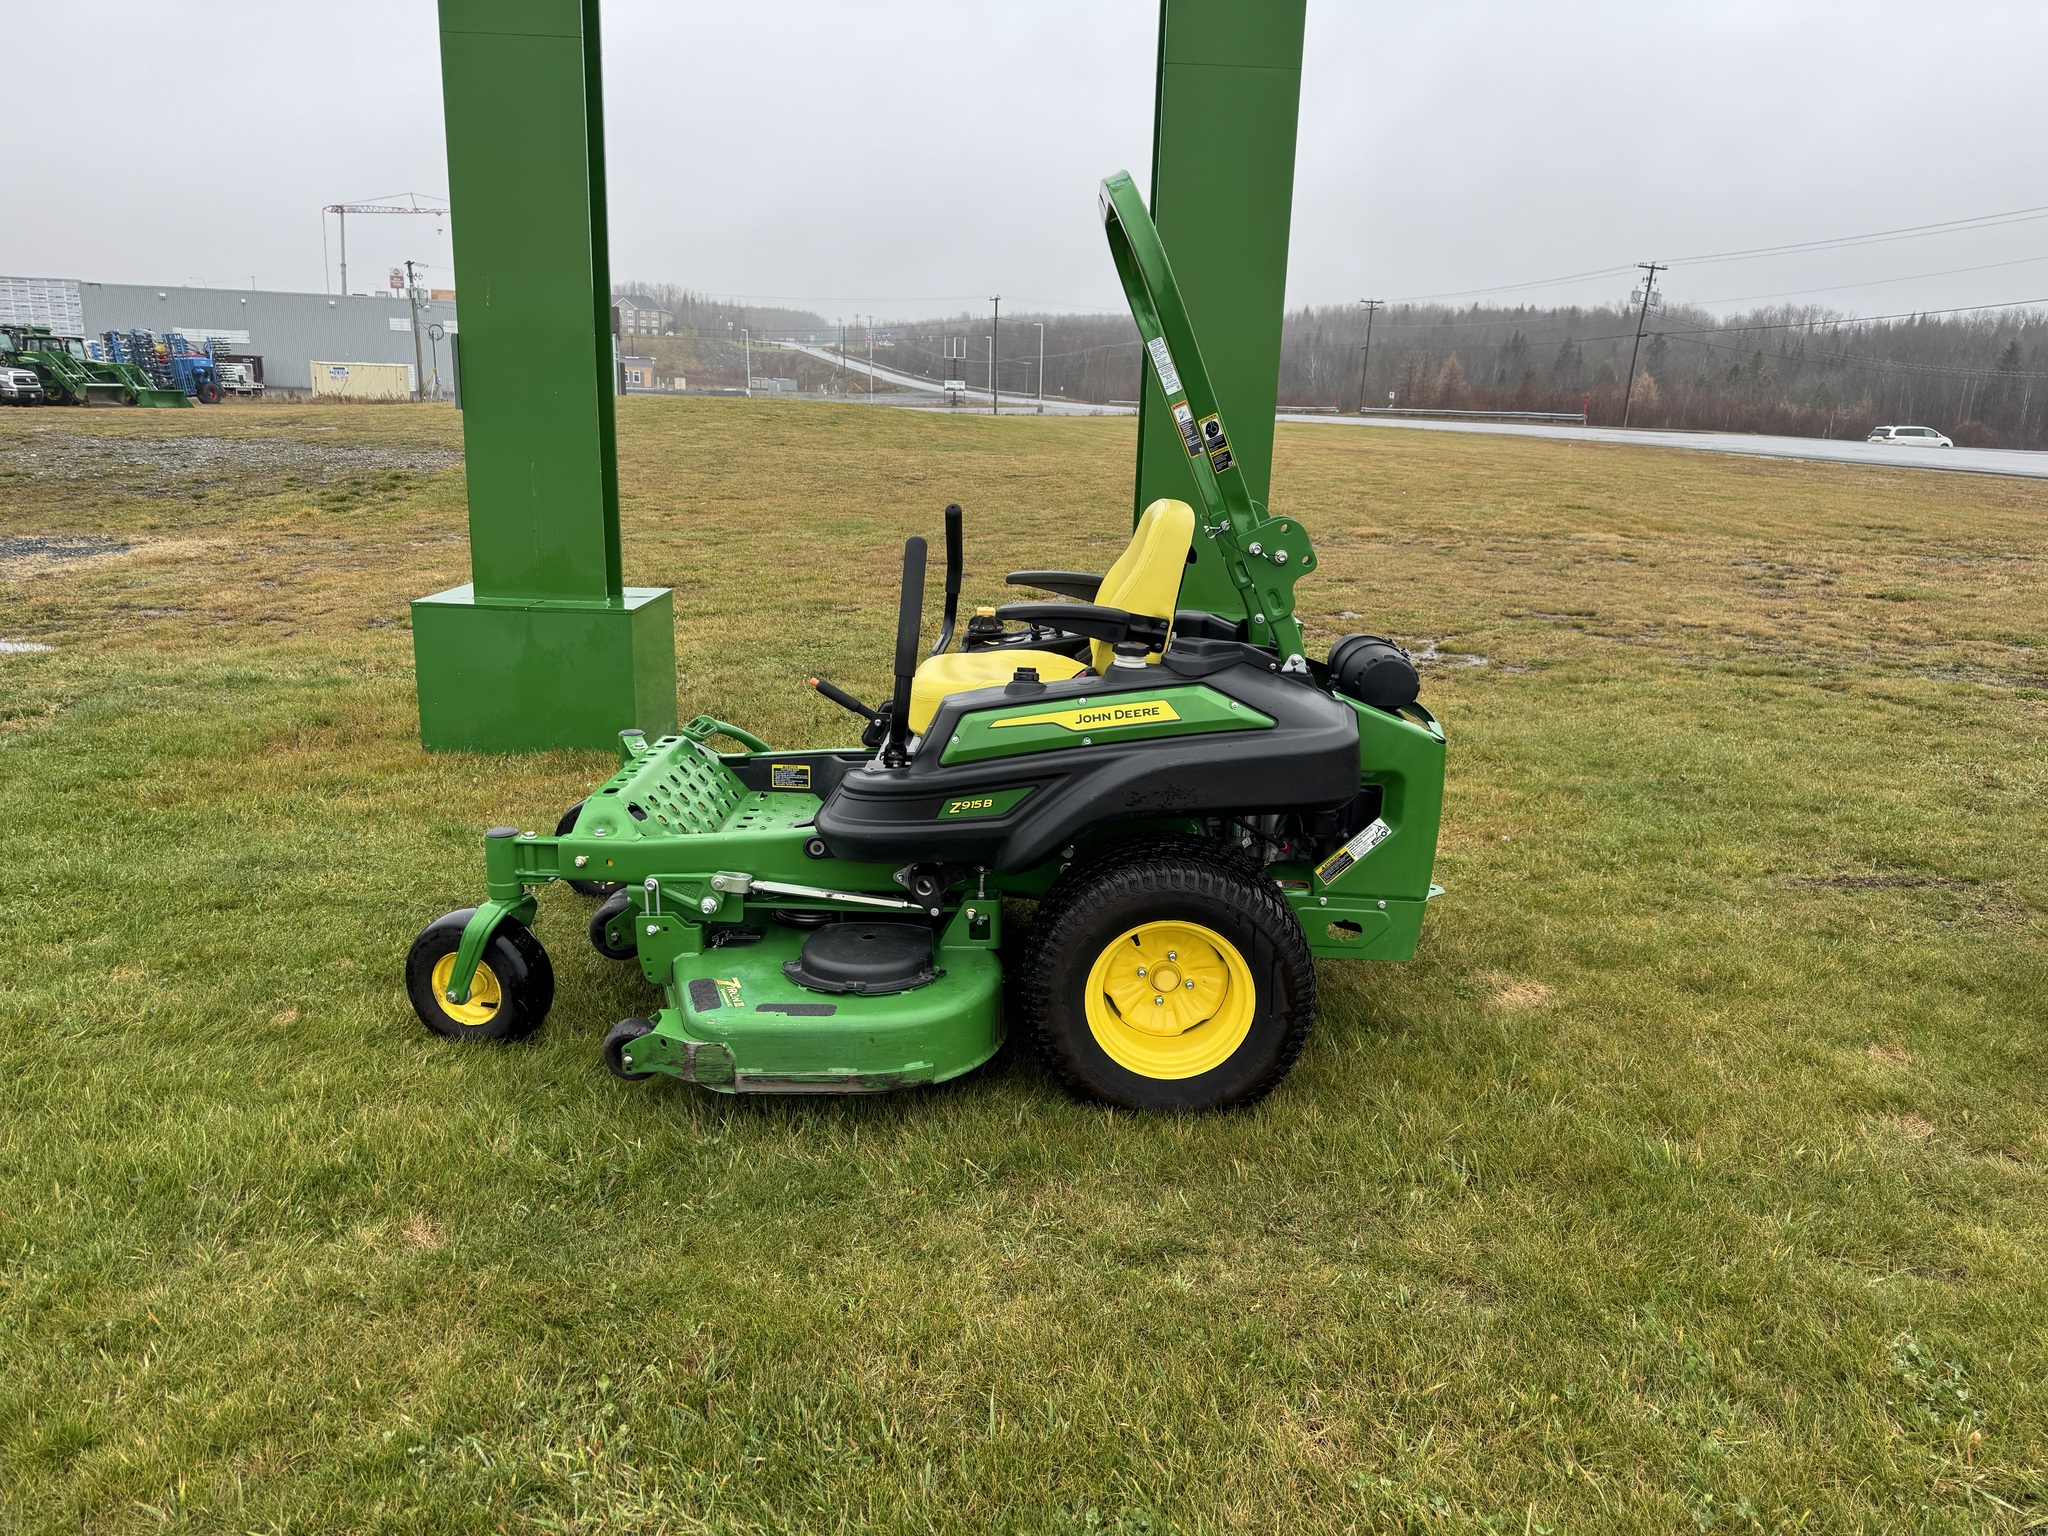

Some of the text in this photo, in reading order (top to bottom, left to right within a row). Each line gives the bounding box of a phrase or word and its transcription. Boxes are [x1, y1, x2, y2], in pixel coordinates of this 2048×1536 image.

[1075, 707, 1160, 724] JOHN DEERE
[949, 799, 993, 813] Z915B
